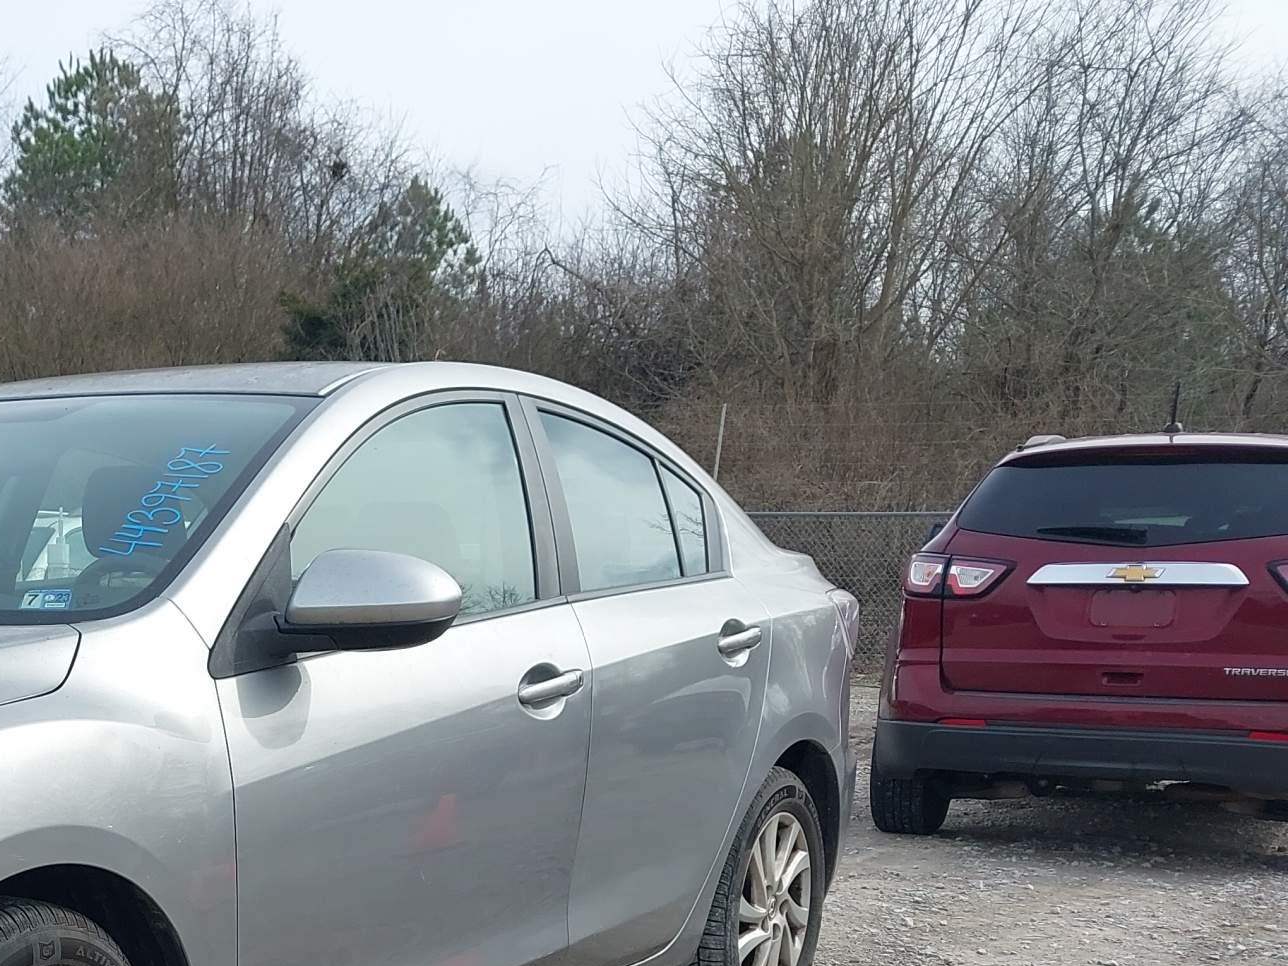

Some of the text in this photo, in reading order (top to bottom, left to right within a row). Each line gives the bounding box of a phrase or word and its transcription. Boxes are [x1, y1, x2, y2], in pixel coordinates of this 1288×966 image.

[98, 443, 232, 556] 44397187
[27, 593, 40, 606] 7
[1223, 667, 1288, 677] TRAVERS
